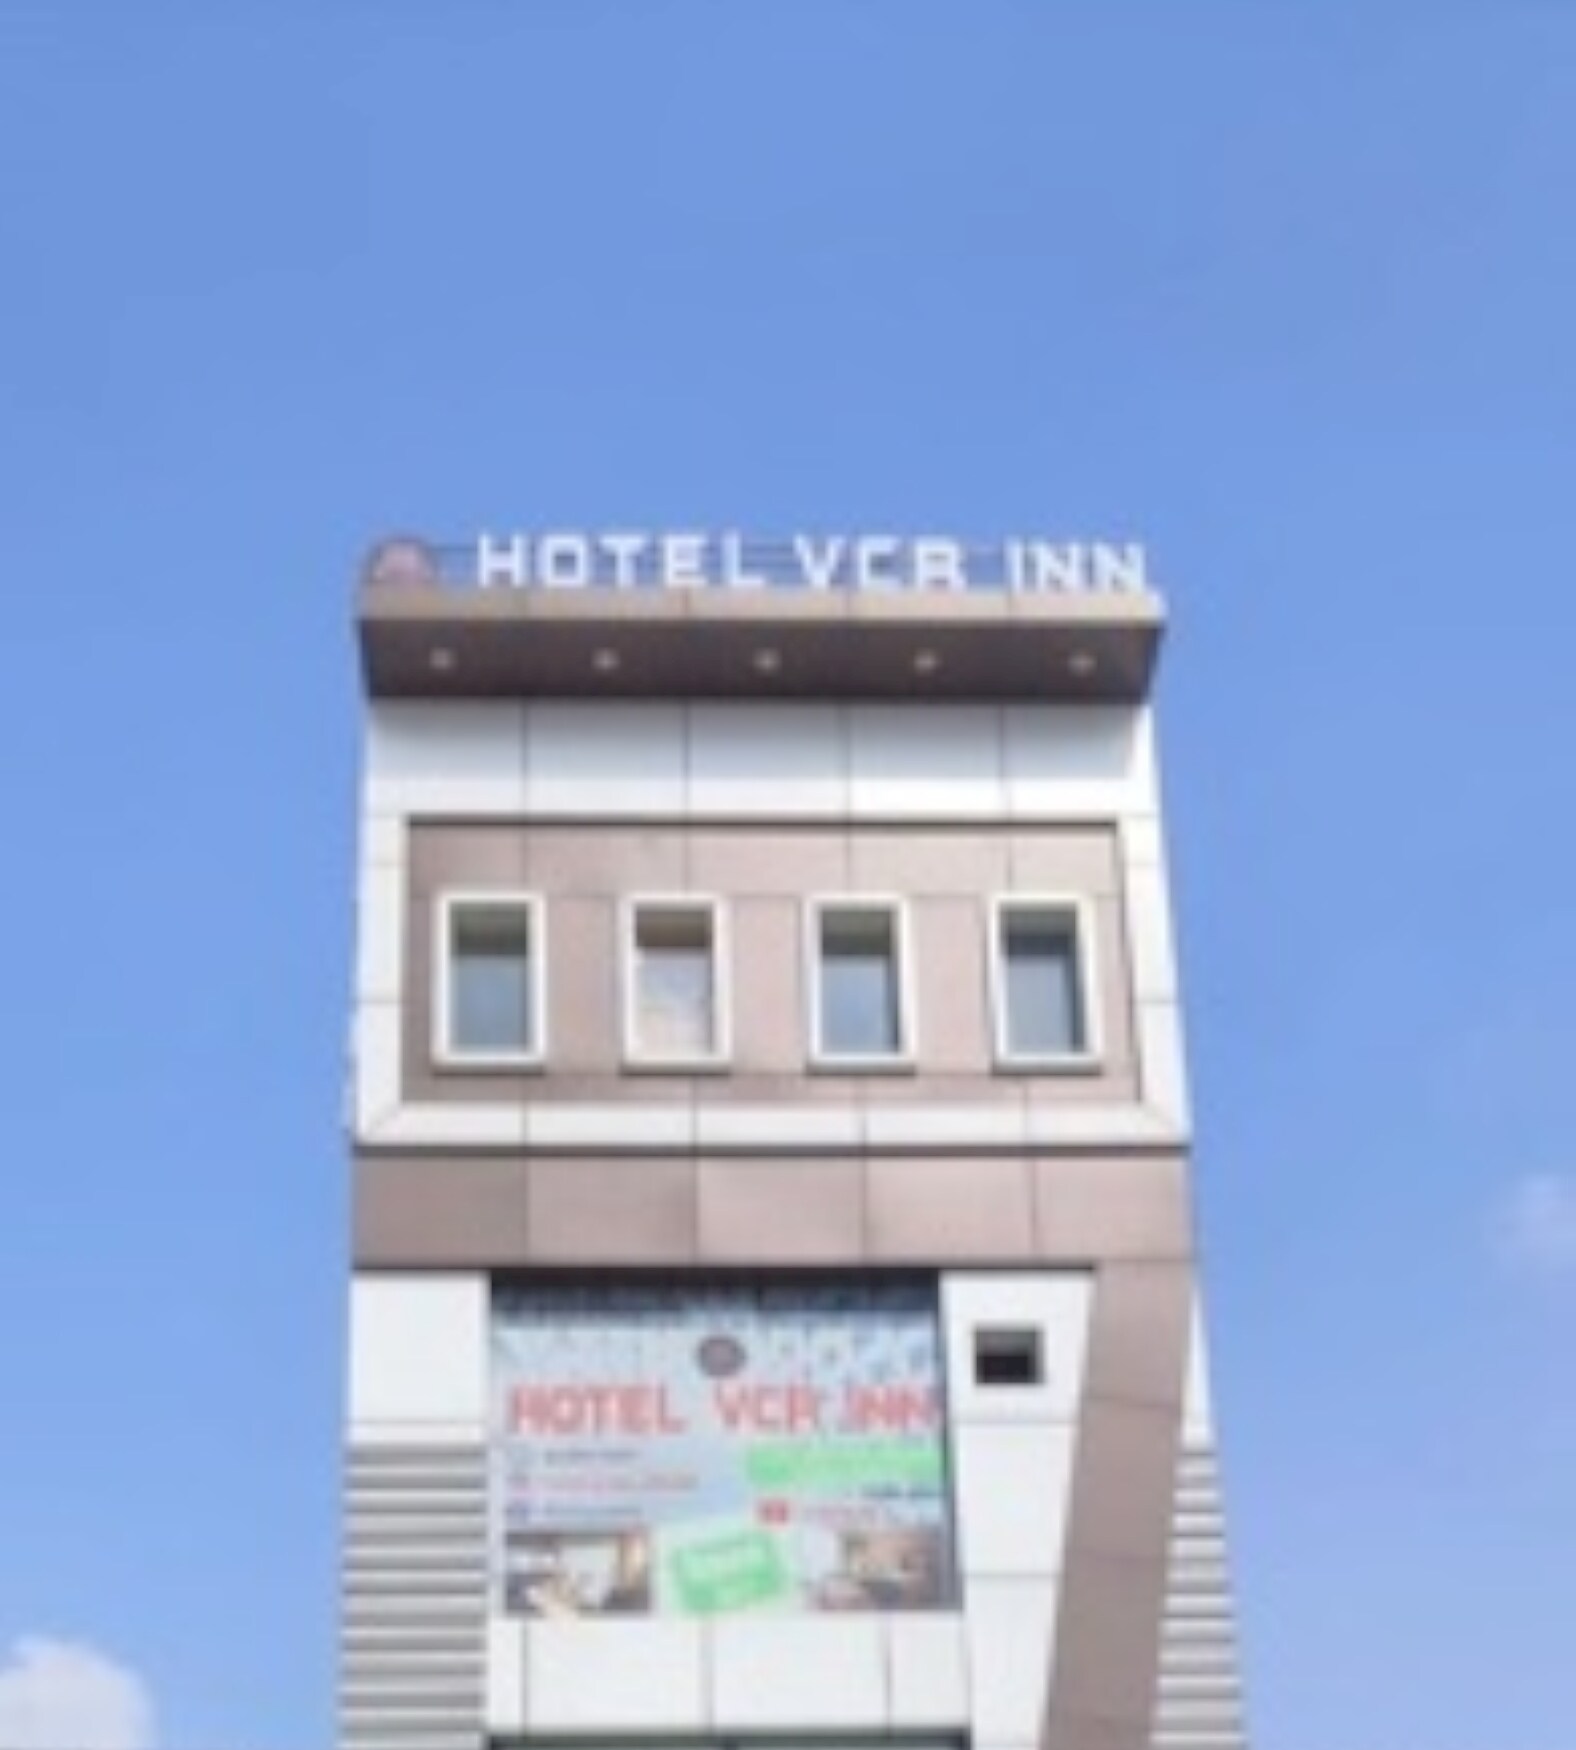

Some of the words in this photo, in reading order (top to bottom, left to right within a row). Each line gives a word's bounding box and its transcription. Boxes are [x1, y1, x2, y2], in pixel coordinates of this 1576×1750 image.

[476, 534, 765, 589] HOTEL
[798, 536, 968, 590] VCR
[1004, 540, 1147, 592] INN
[510, 1382, 687, 1437] HOTEL
